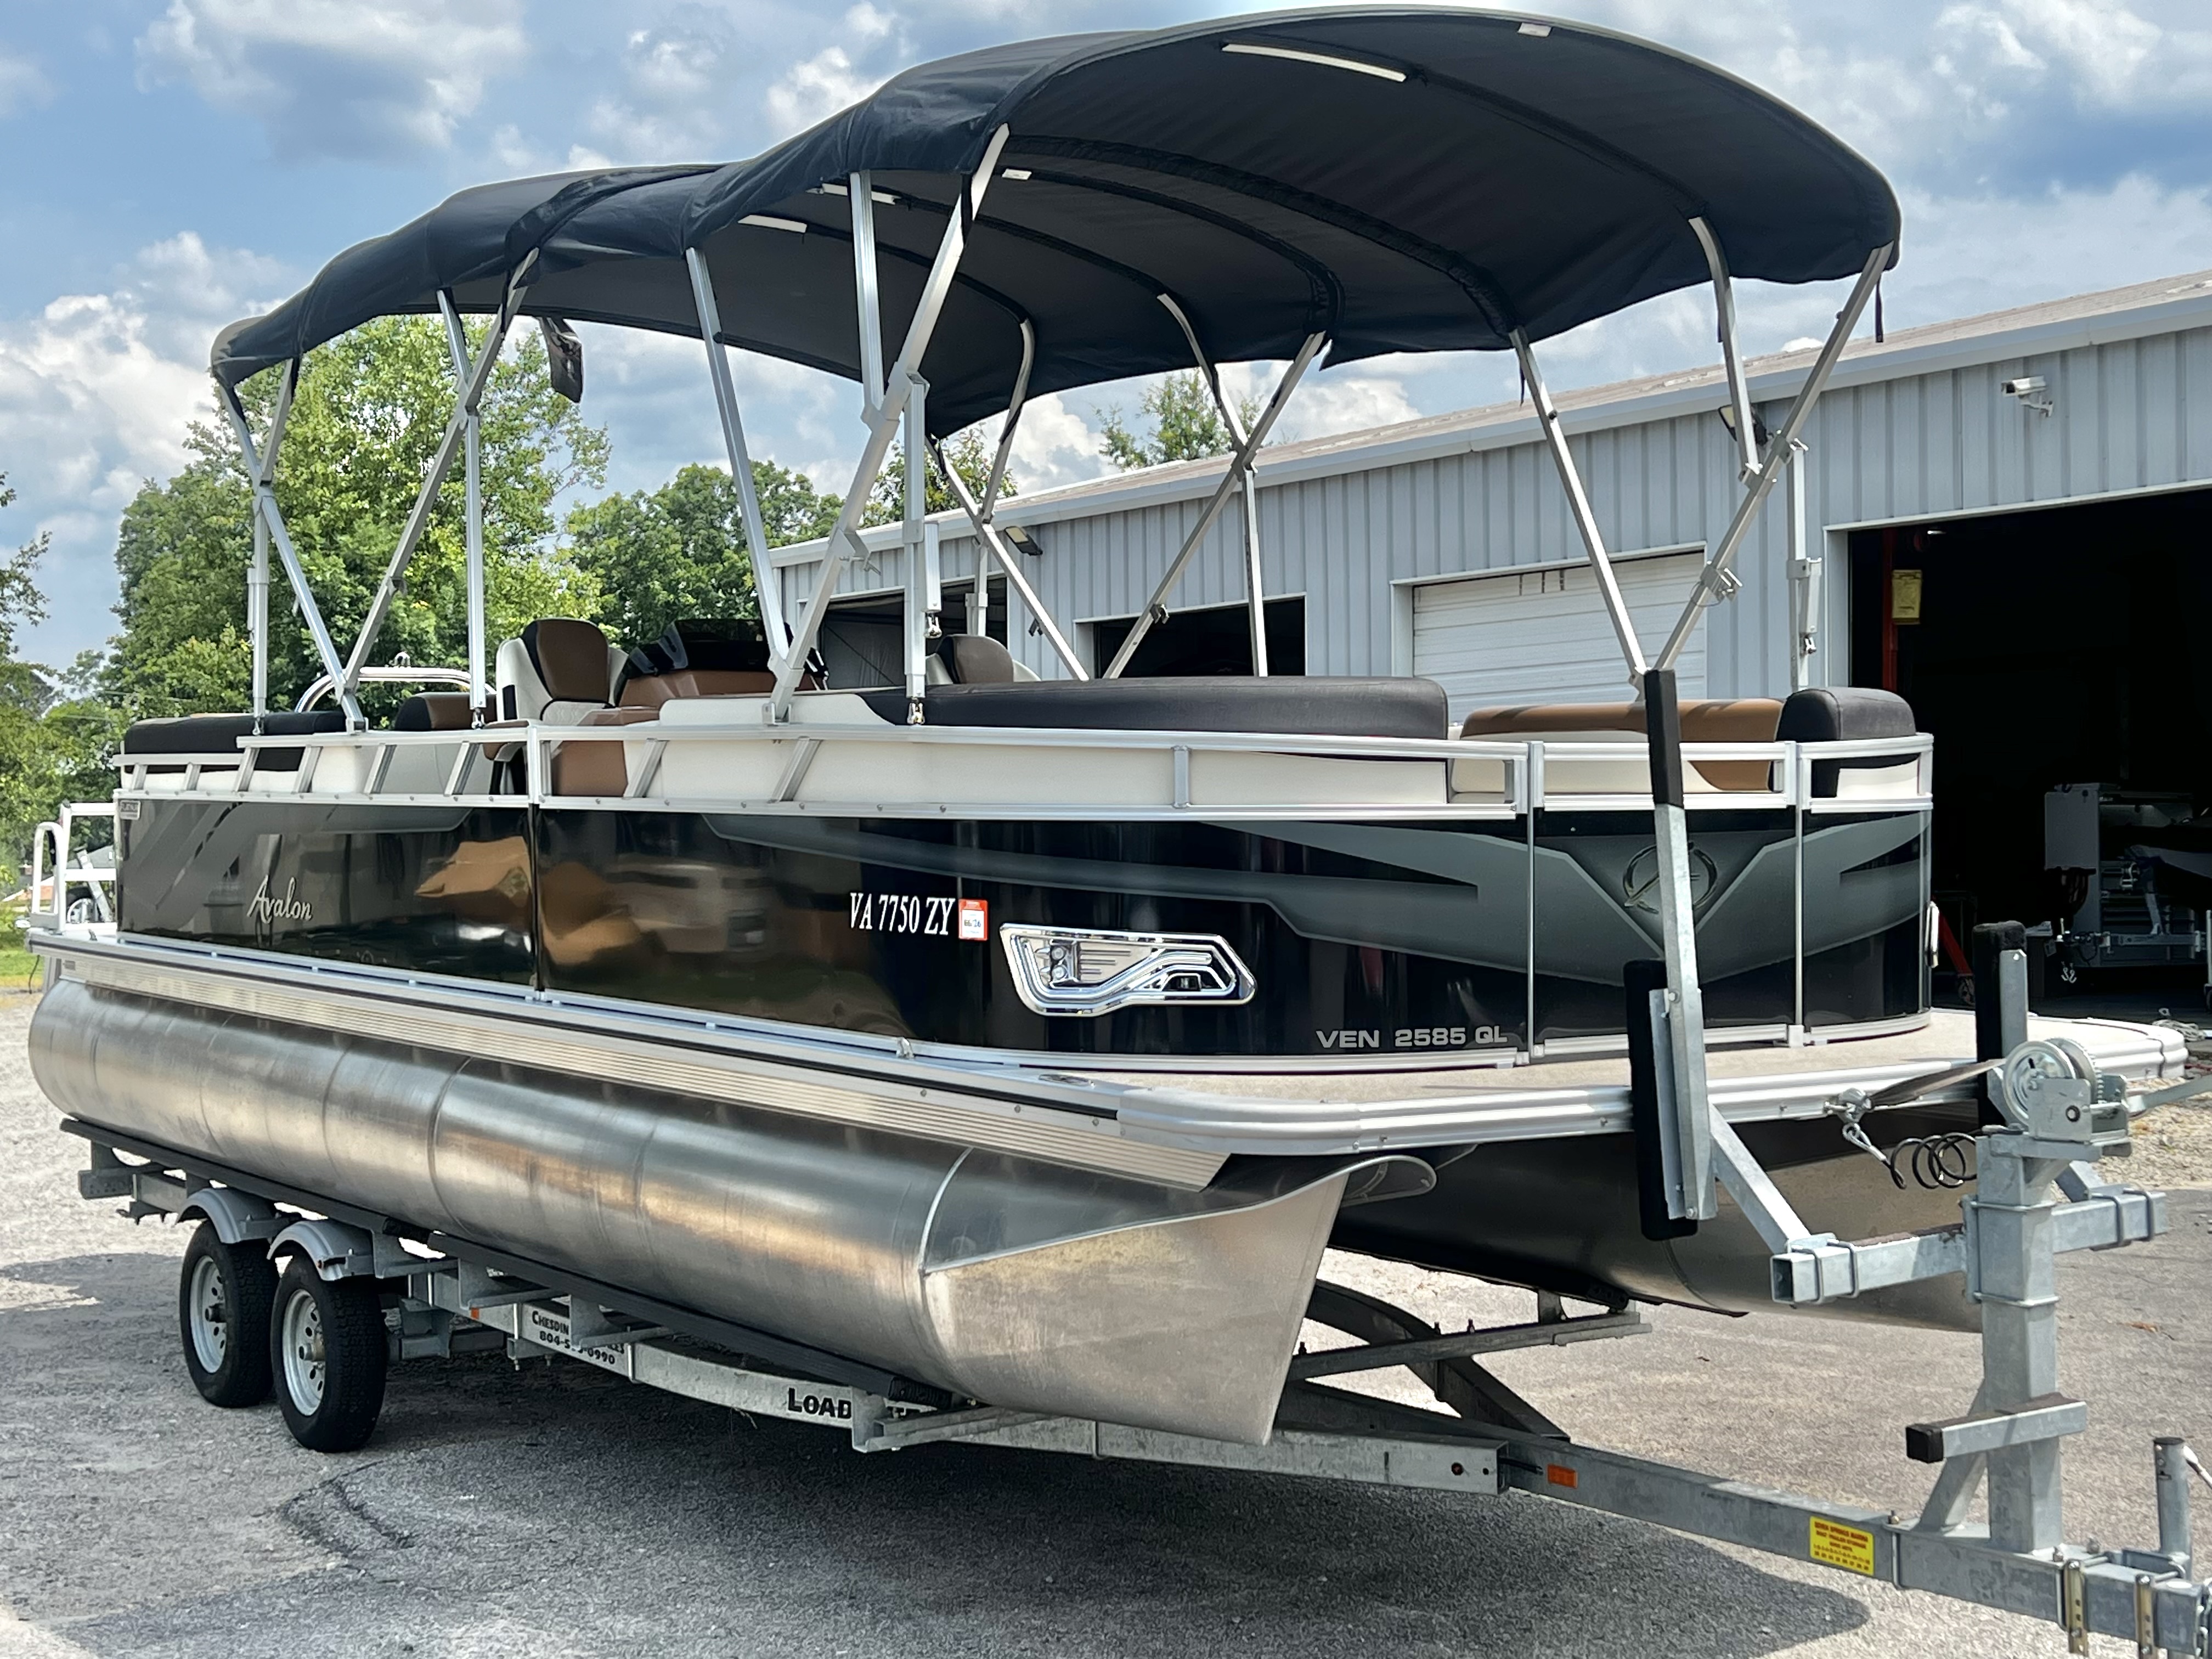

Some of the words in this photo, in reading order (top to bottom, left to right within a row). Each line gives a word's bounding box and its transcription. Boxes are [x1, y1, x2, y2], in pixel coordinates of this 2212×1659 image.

[247, 874, 312, 924] Avalon
[850, 892, 873, 930] VA
[878, 894, 920, 934] 7750
[924, 897, 956, 936] ZY
[1316, 1029, 1380, 1048] VEN
[1395, 1026, 1466, 1047] 2585
[1475, 1025, 1508, 1043] QL
[787, 1387, 852, 1419] LOAD
